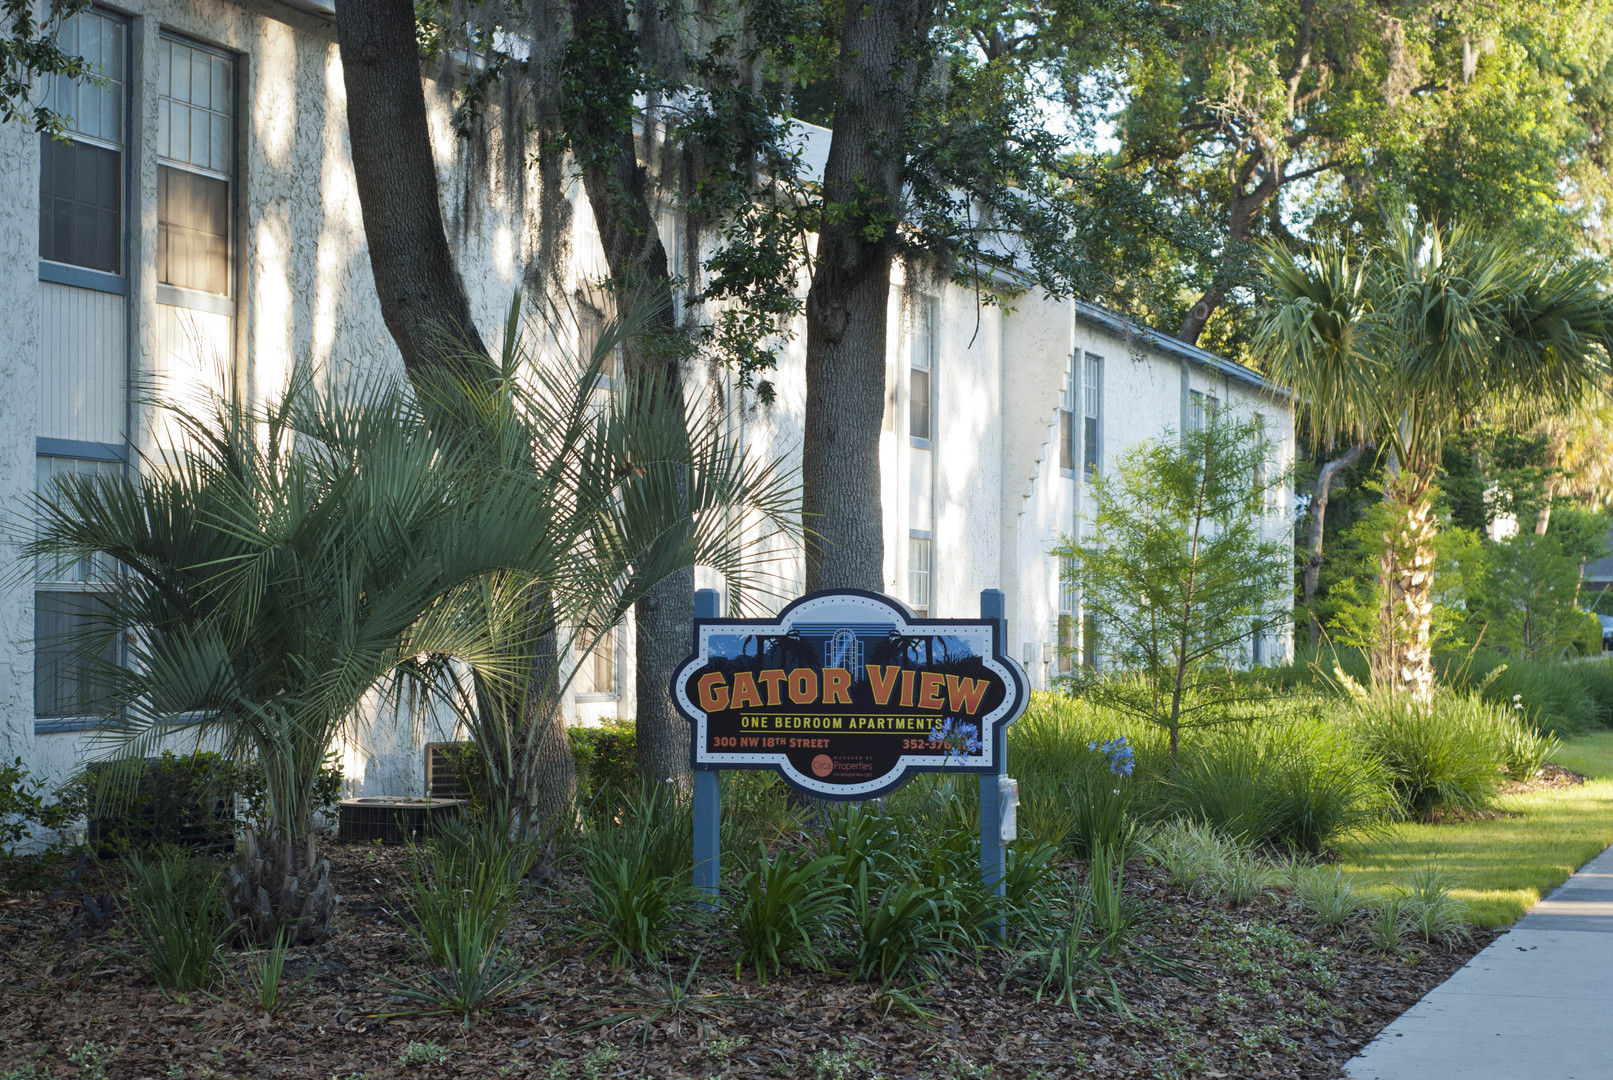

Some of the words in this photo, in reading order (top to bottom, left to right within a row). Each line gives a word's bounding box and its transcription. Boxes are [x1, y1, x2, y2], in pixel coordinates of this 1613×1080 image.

[698, 667, 852, 712] GATOR
[865, 664, 990, 715] VIEW
[741, 716, 768, 729] ONE
[775, 717, 842, 729] BEDROOM
[849, 717, 943, 730] APARTMENTS
[713, 737, 737, 747] 300
[740, 737, 759, 747] NW
[762, 737, 786, 748] 18TH
[789, 738, 830, 748] STREET
[813, 761, 832, 770] Circa
[833, 761, 873, 771] Properties
